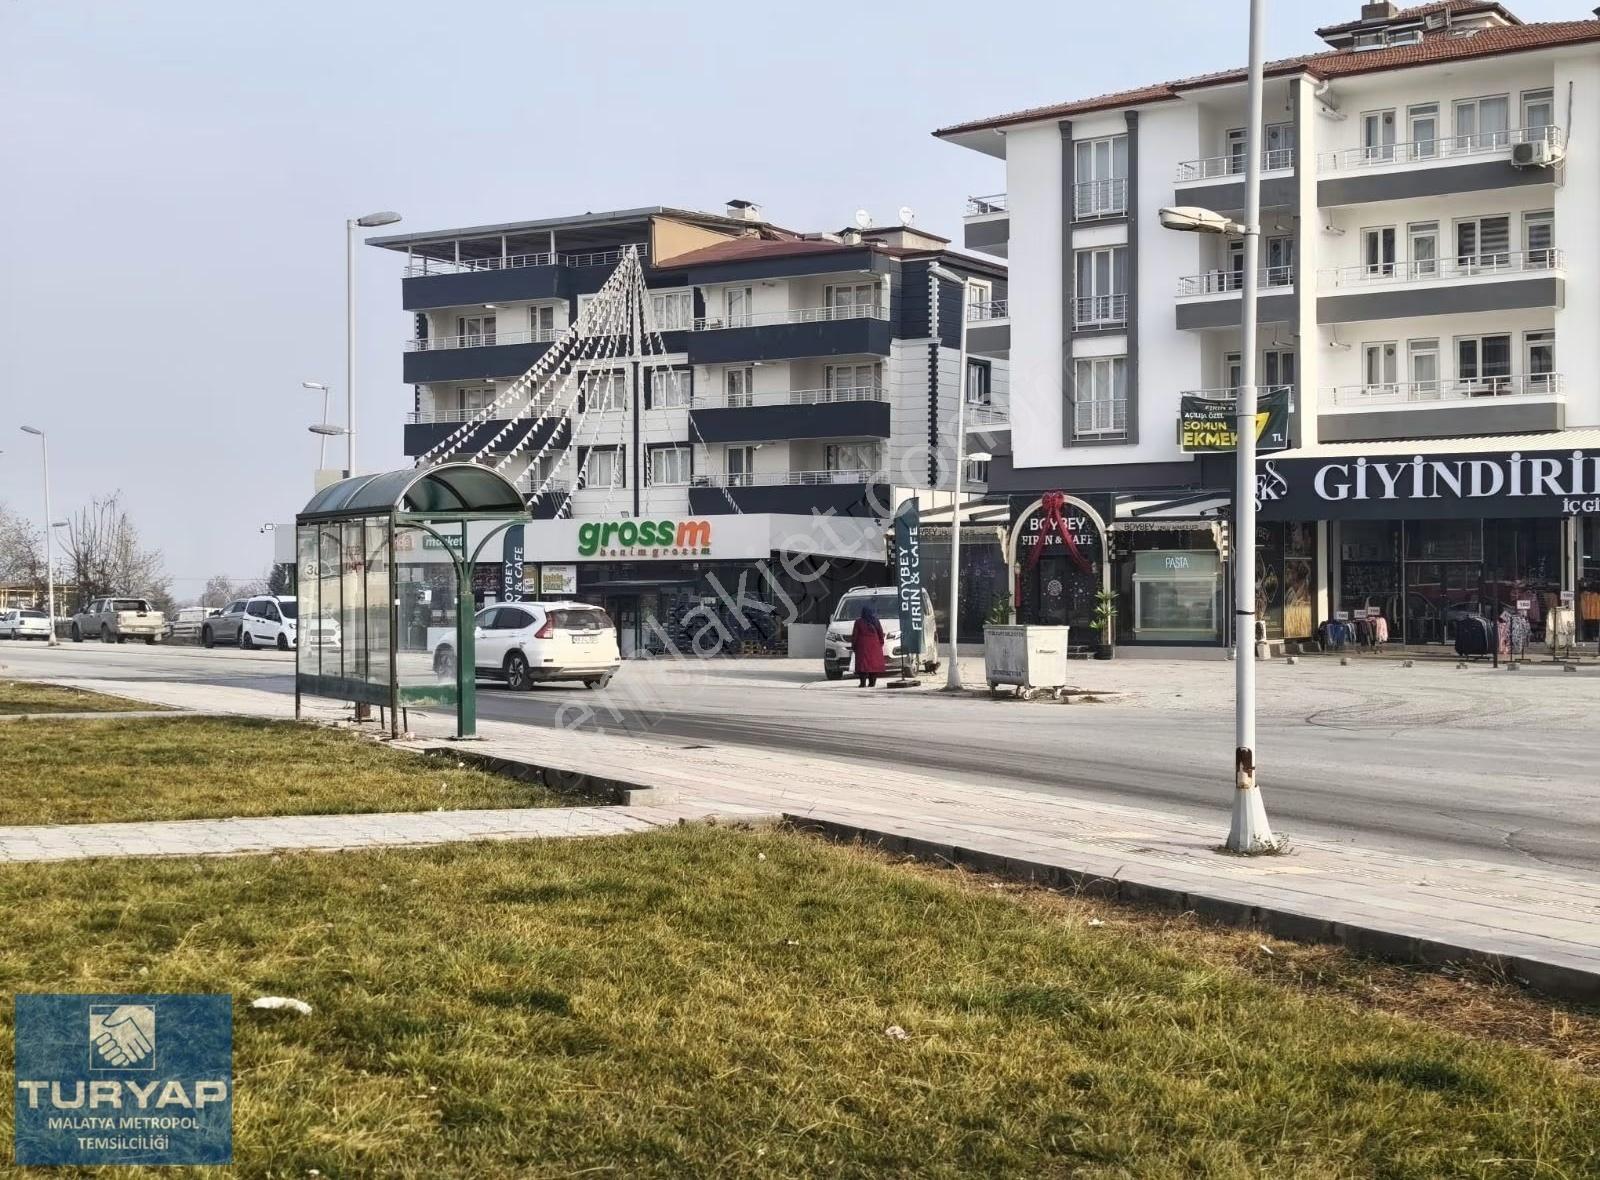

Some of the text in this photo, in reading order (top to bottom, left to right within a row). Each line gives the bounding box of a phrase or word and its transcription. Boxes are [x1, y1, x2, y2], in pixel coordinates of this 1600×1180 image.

[1184, 421, 1227, 430] SOMUN
[1272, 433, 1284, 442] TL
[1562, 497, 1581, 515] İÇ
[425, 535, 463, 547] maket
[1072, 534, 1093, 545] AFE
[514, 546, 523, 579] CAFE
[1165, 557, 1189, 569] PASTA
